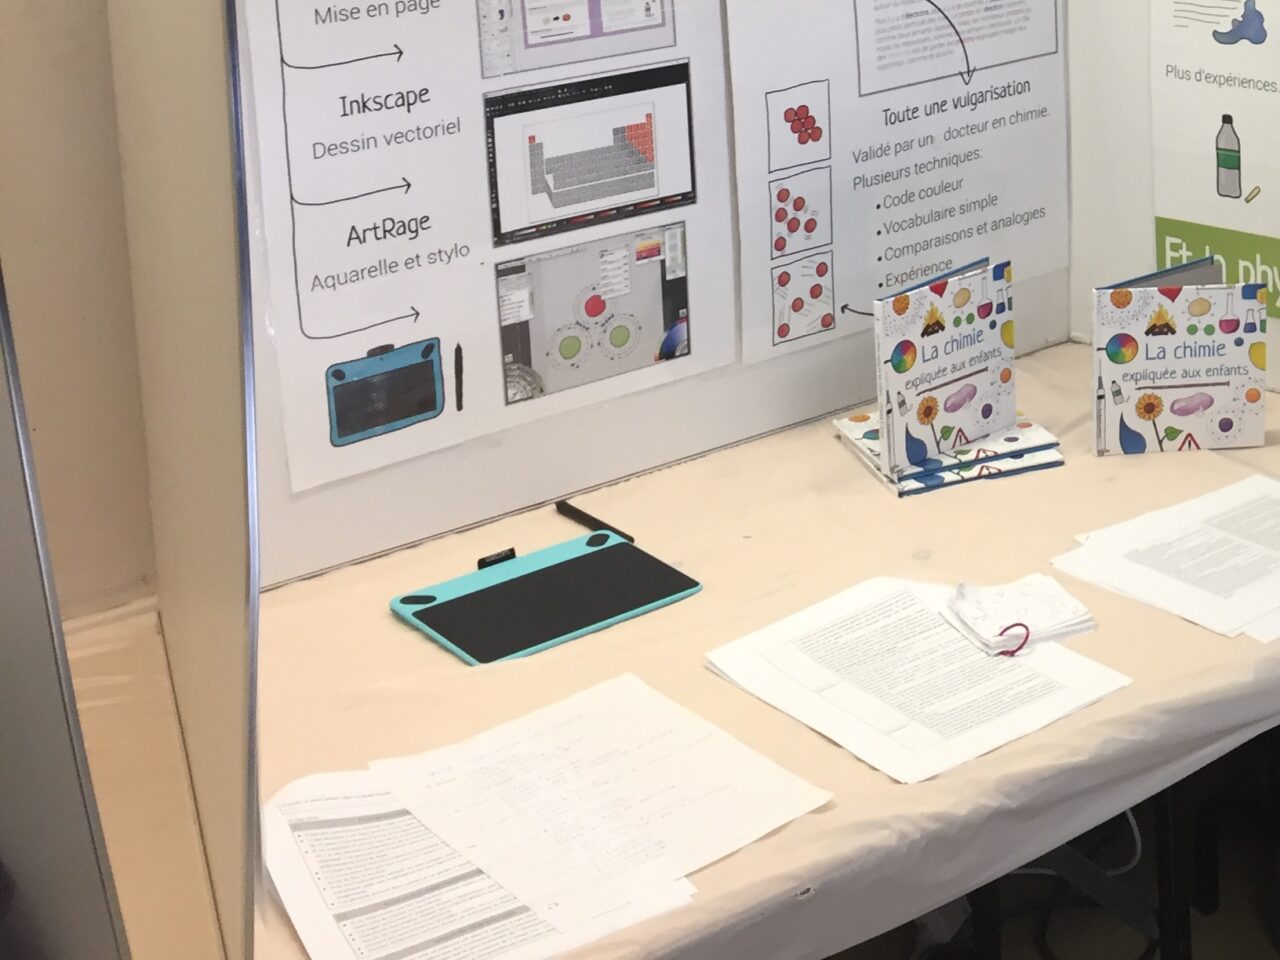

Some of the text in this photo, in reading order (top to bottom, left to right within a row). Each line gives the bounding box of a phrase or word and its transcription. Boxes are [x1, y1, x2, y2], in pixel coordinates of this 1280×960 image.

[313, 5, 361, 26] Mise
[367, 3, 390, 19] en
[1166, 64, 1280, 94] Plus d'expériences.
[339, 87, 431, 118] Inkscape
[882, 80, 1031, 126] Toute une vulgarisation
[312, 117, 461, 160] Dessin vectoriel
[852, 148, 983, 190] Plusieurs techniques:
[883, 177, 964, 209] Code couleur
[346, 212, 431, 247] ArtRage
[883, 193, 998, 235] Vocabulaire simple
[884, 207, 1046, 262] Comparaisons et analogies
[310, 243, 470, 292] Aquarelle et stylo
[885, 258, 953, 288] Expérience
[922, 328, 984, 363] La chimie
[1145, 339, 1226, 360] La chimie
[905, 347, 1002, 391] expliquée aux enfants
[1122, 363, 1249, 383] expliquée aux enfants
